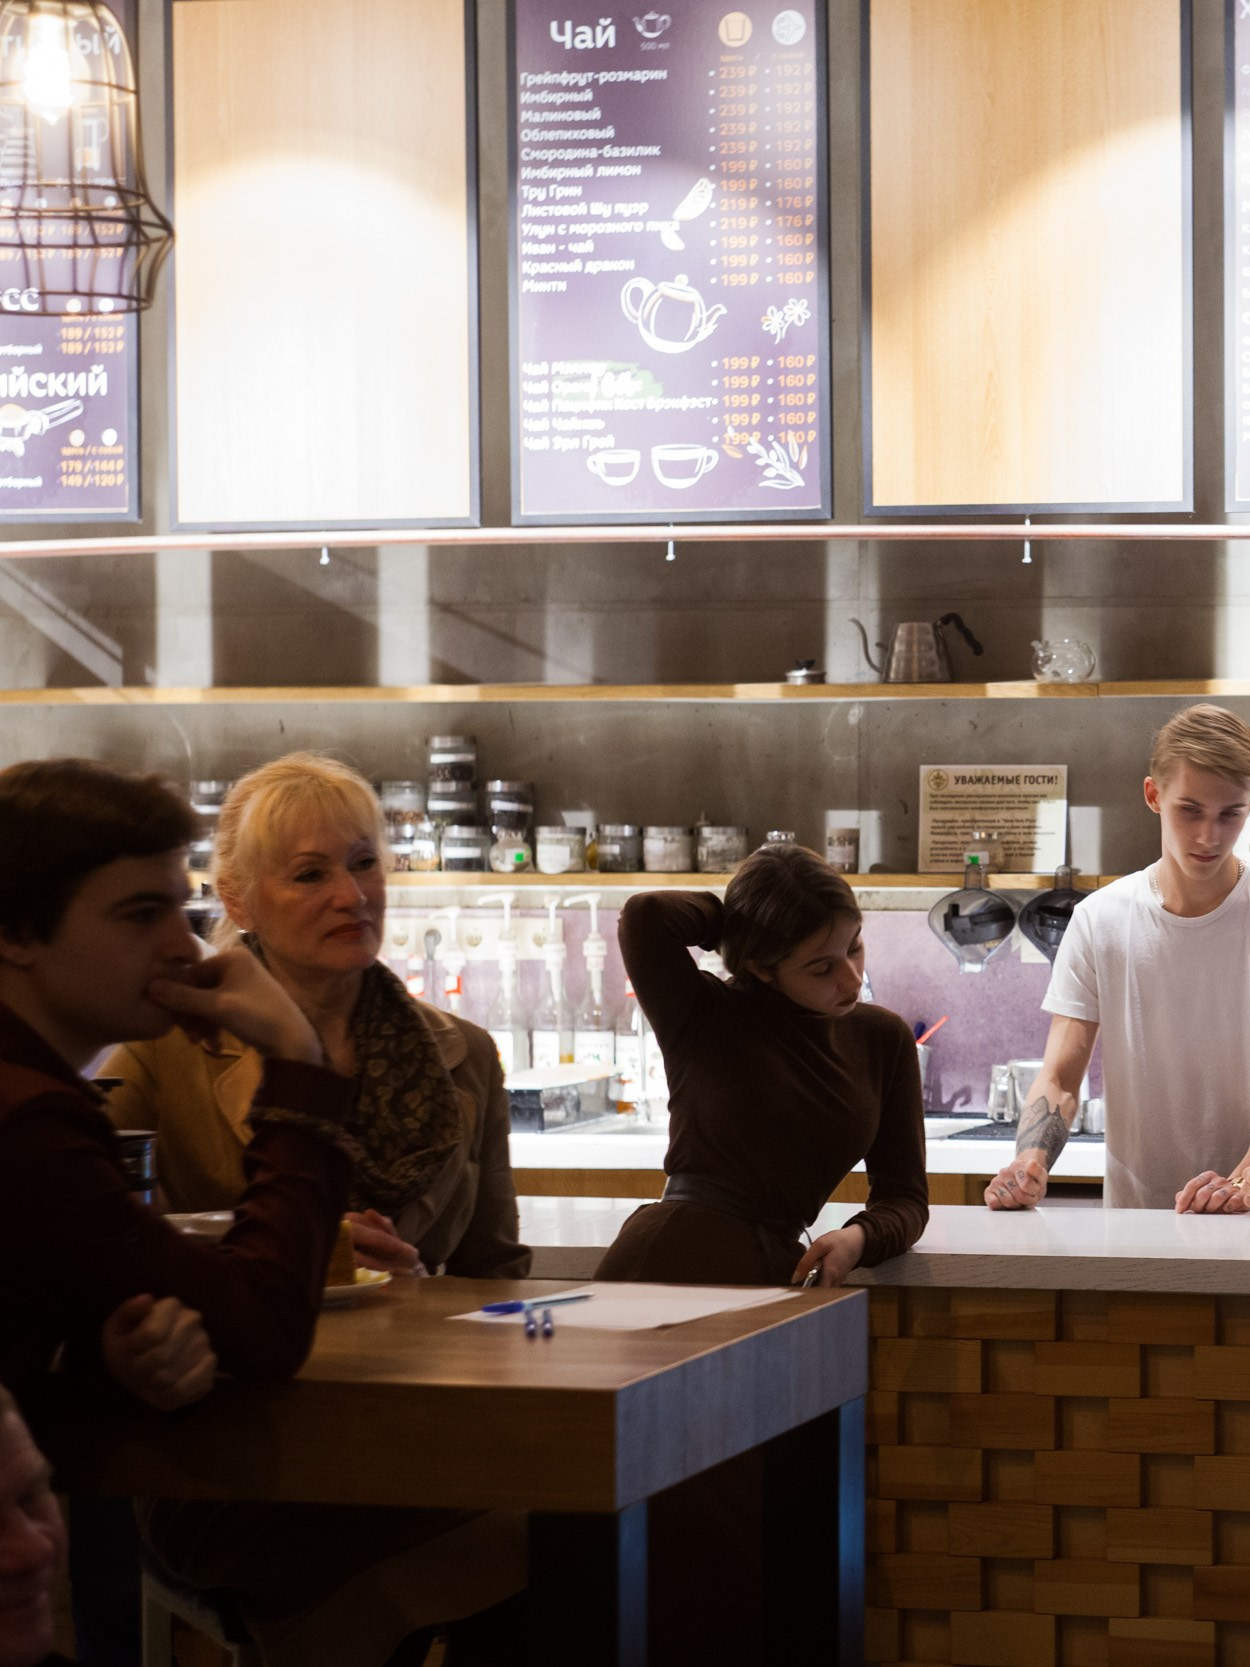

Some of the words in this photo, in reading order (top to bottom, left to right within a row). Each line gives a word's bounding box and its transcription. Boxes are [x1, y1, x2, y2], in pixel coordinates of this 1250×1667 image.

[549, 17, 616, 50] Чай
[520, 69, 668, 87] Грейпфрут-розмарин
[520, 88, 593, 105] Имбирный
[521, 107, 601, 123] Малиновый
[521, 126, 615, 142] Облепиховый
[521, 145, 661, 162] Смородина-базилик
[596, 164, 642, 177] лимон
[521, 202, 588, 218] Листовой
[522, 259, 582, 276] Красный
[954, 775, 1020, 785] УВАЖАЕМЫЕ
[1024, 775, 1058, 785] ГОСТИ!
